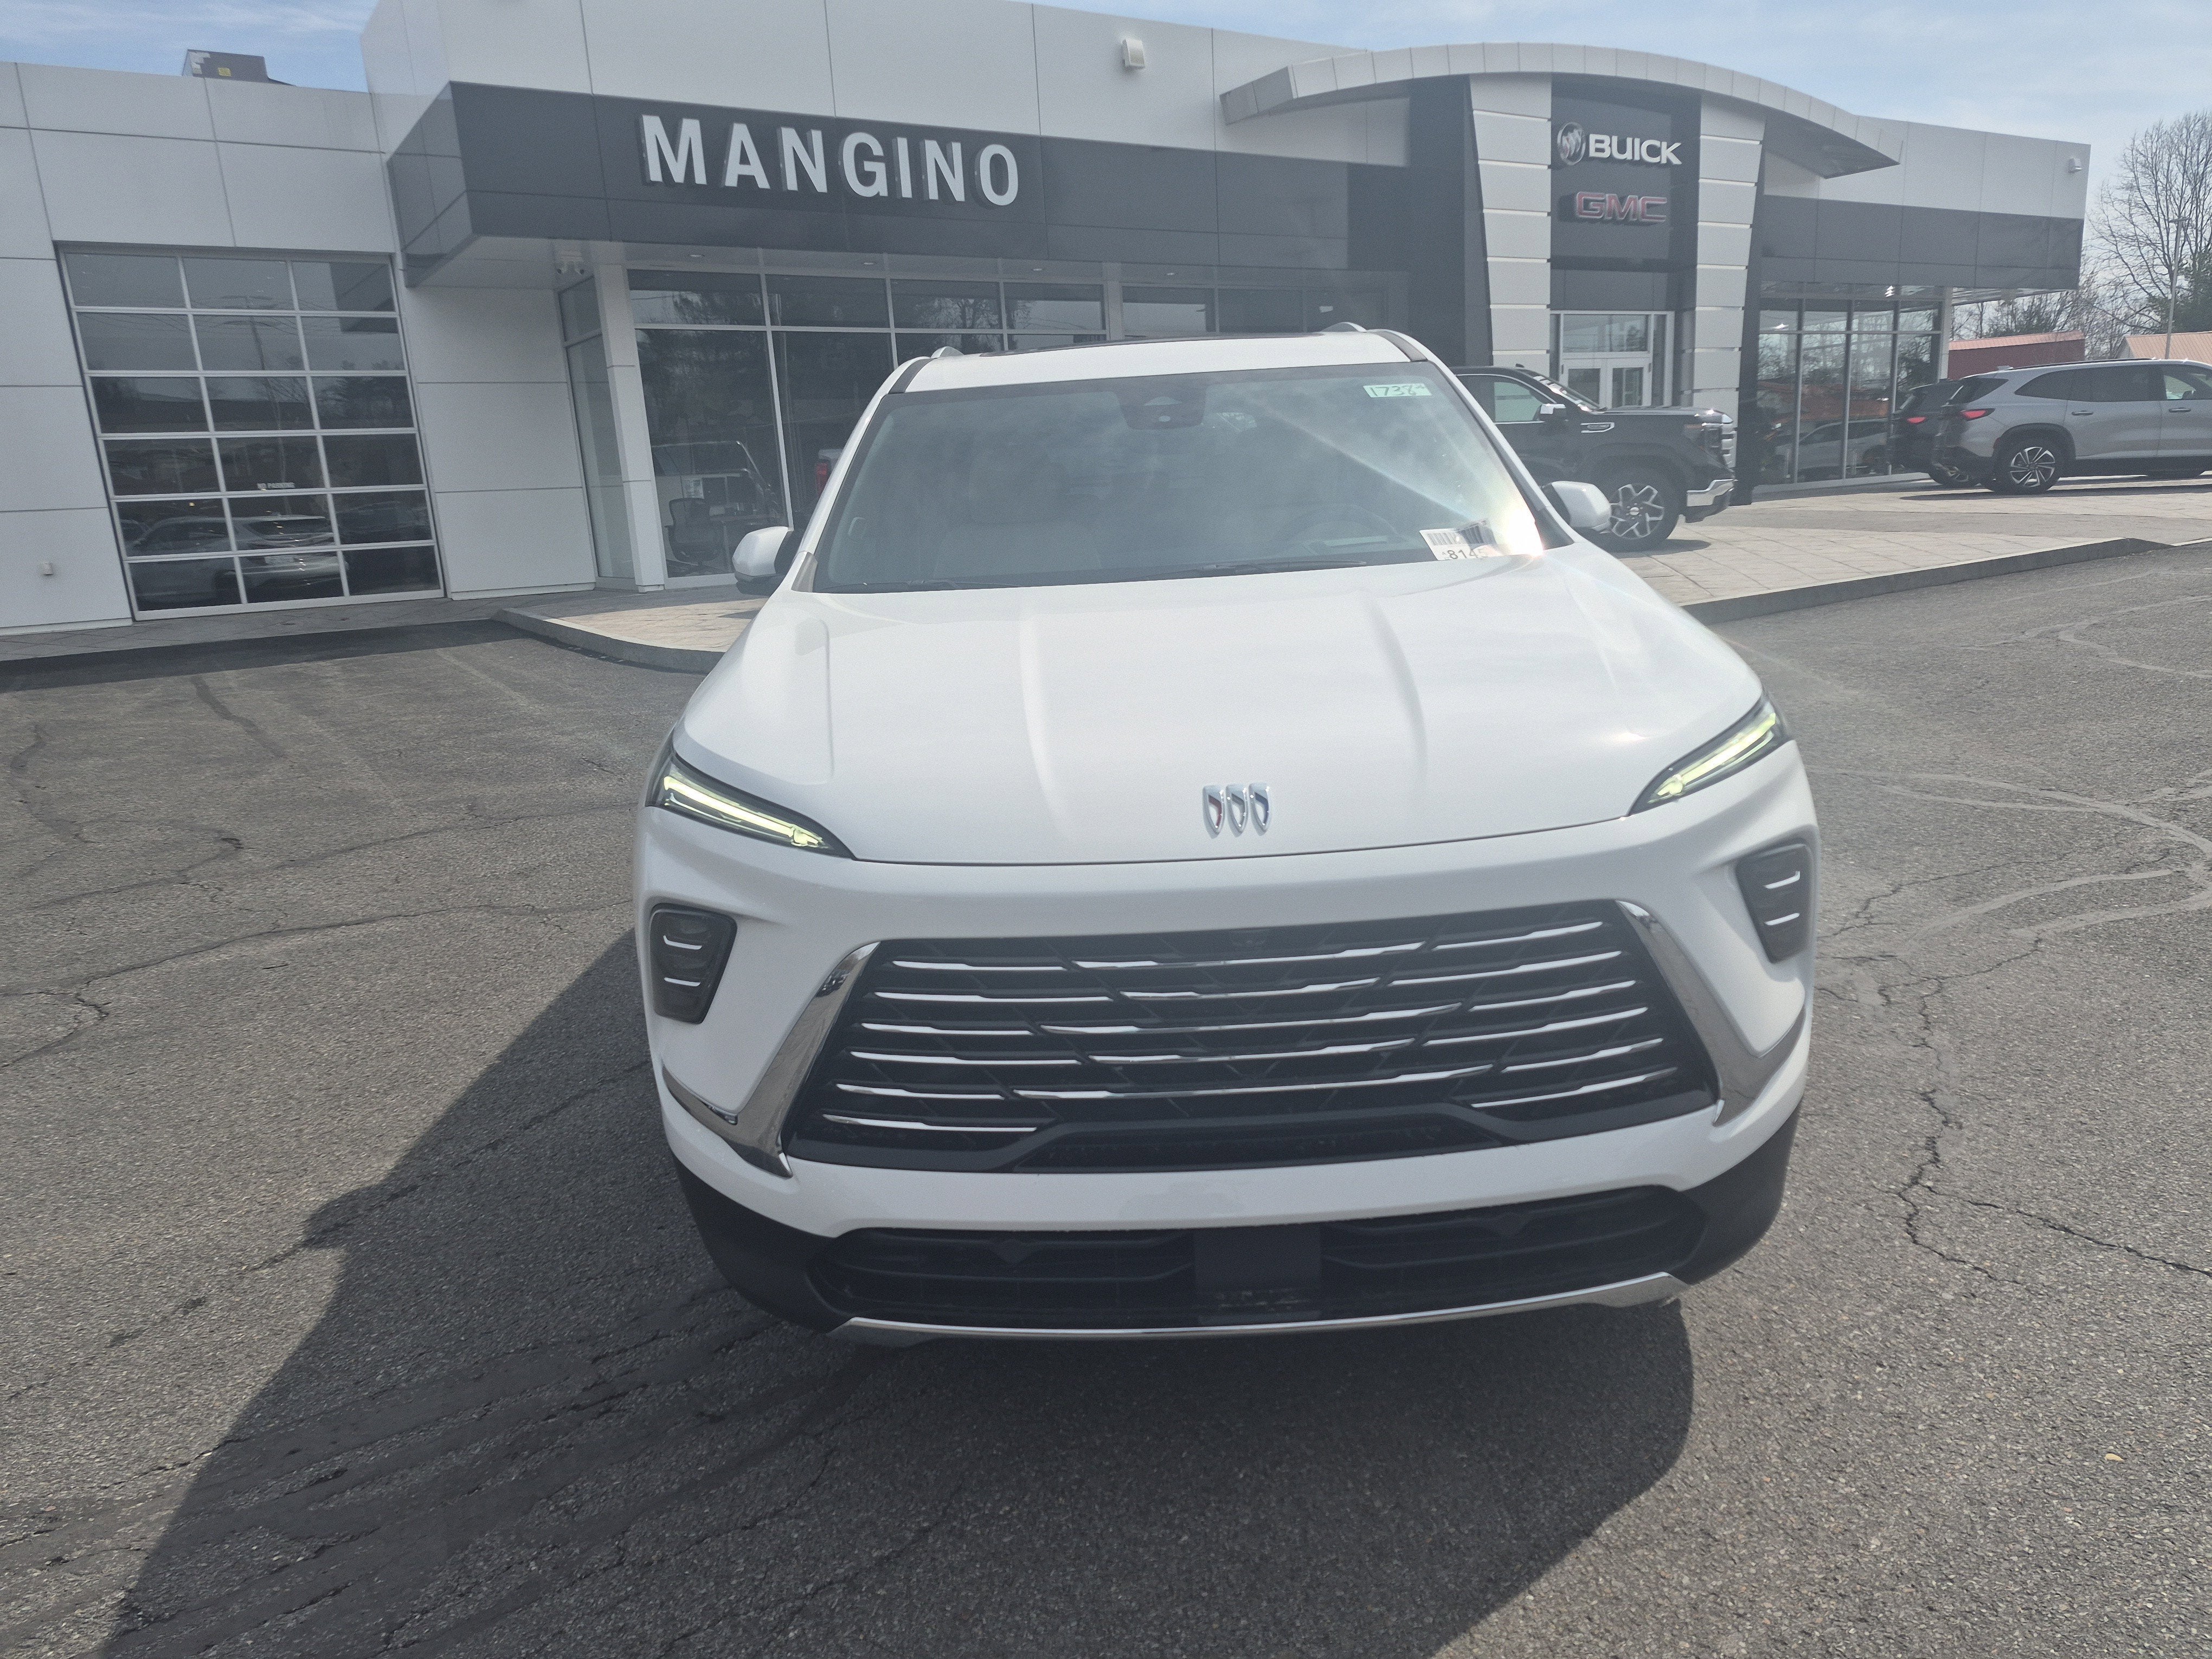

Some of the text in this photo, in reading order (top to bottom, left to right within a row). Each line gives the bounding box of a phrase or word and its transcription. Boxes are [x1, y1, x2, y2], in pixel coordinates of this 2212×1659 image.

[639, 114, 1019, 205] MANGINO
[1589, 133, 1682, 164] BUICK
[1576, 191, 1667, 222] GMC
